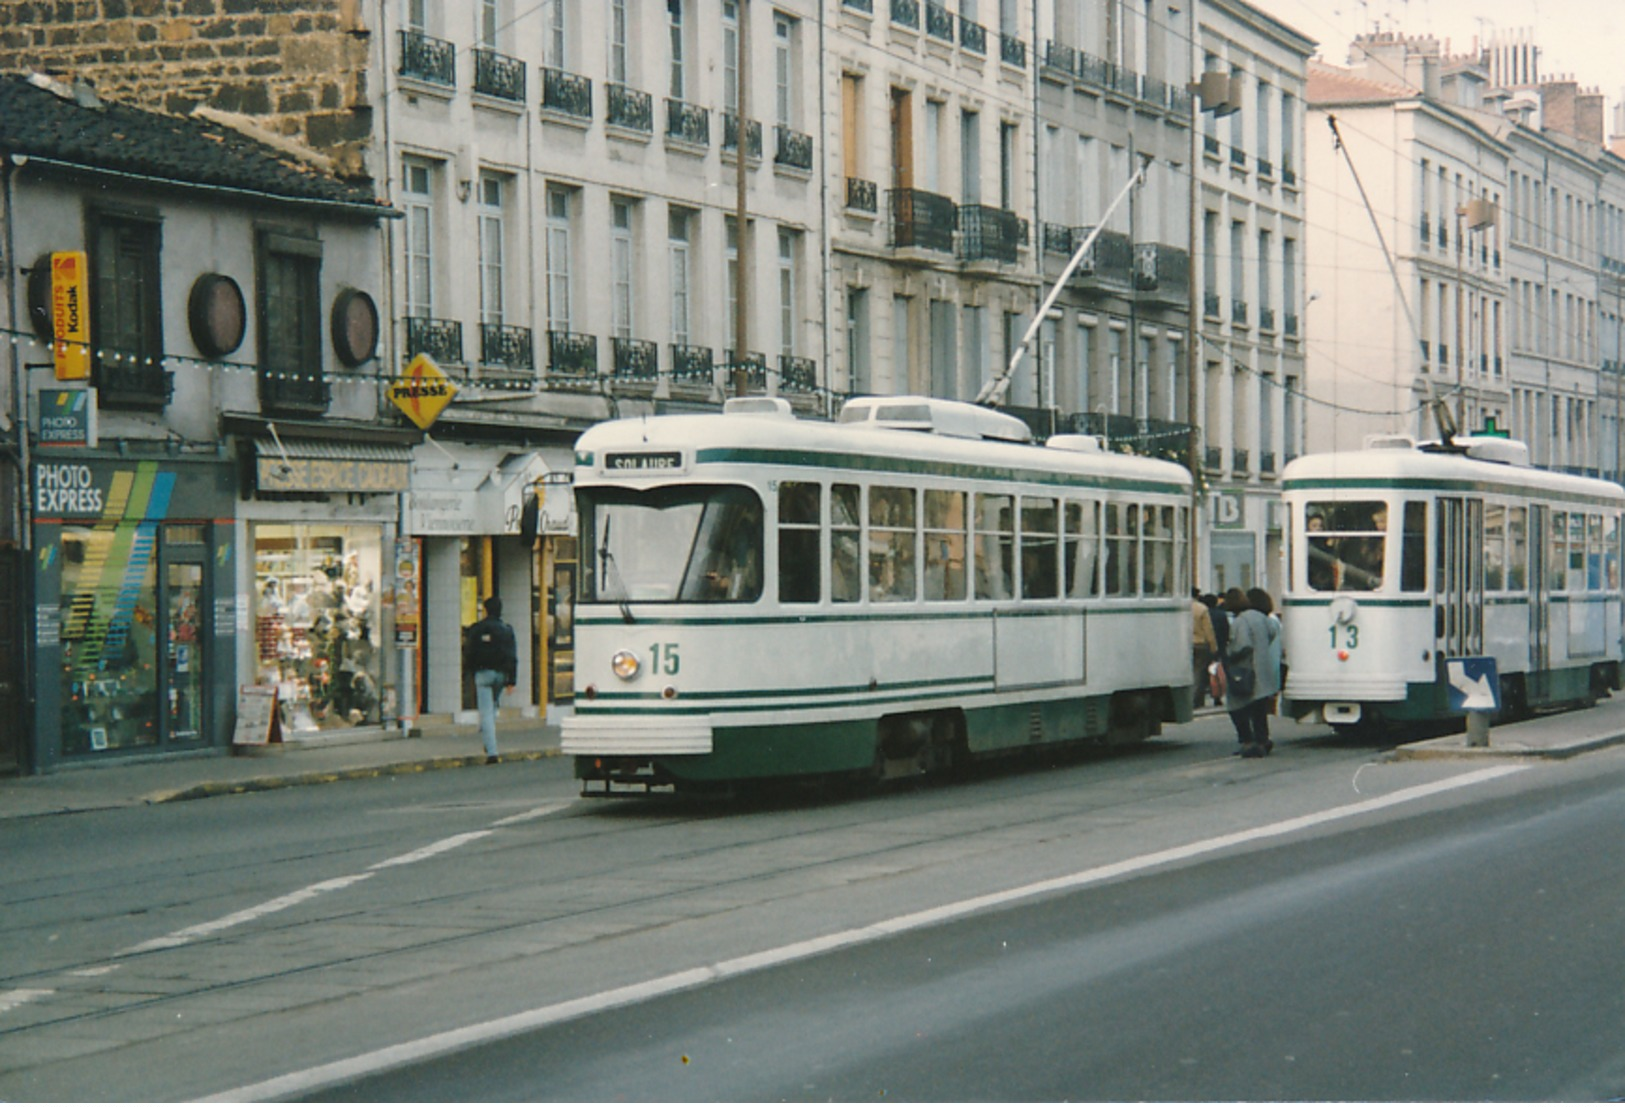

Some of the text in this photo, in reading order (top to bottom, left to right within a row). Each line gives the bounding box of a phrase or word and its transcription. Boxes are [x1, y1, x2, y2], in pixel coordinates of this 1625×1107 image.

[66, 284, 79, 333] Kodak
[55, 285, 66, 359] PRODUITS
[394, 384, 447, 398] PRESSE
[42, 417, 77, 428] PHOTO
[42, 429, 85, 440] EXPRESS
[37, 464, 92, 488] PHOTO
[37, 489, 102, 512] EXPRESS
[1328, 624, 1359, 649] 13
[649, 642, 680, 676] 15
